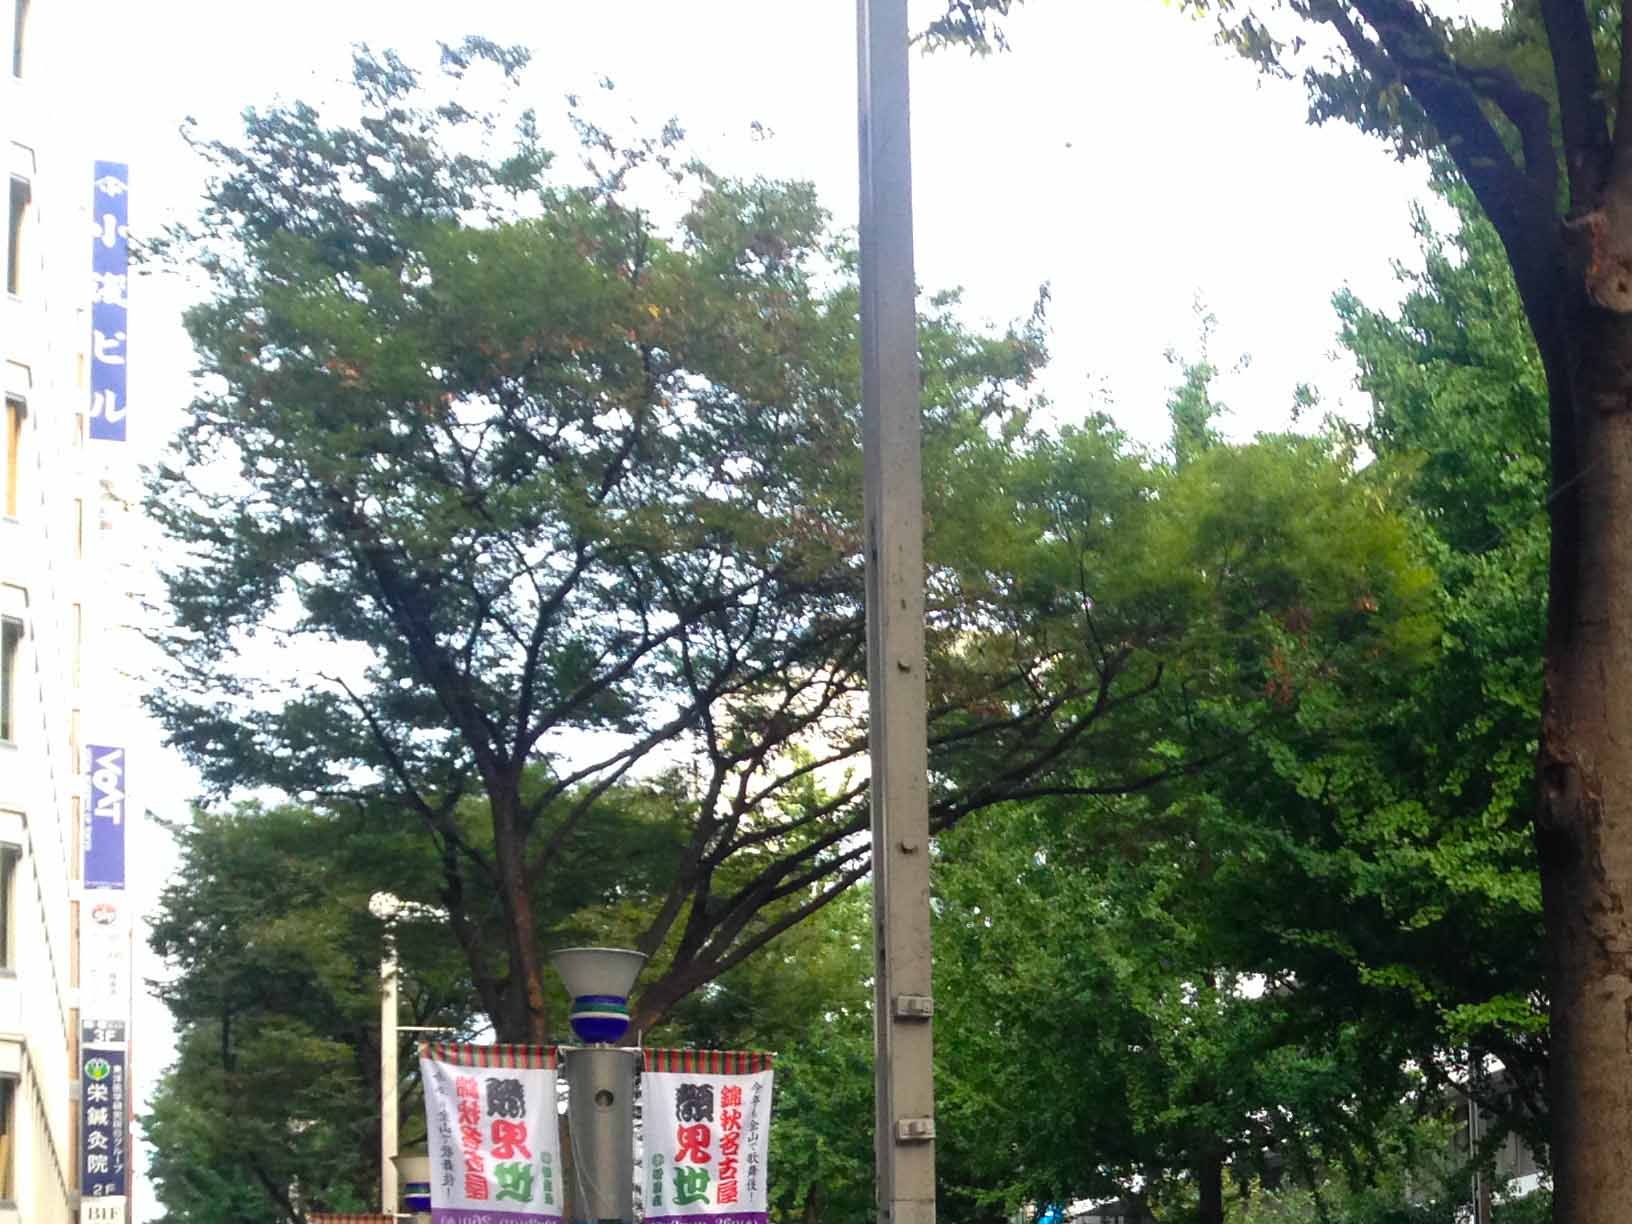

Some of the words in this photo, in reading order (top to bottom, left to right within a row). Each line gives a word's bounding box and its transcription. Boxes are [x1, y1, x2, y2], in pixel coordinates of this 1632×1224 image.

[93, 1028, 117, 1043] 3F
[87, 1083, 109, 1174] 栄鍼灸院
[716, 1084, 743, 1205] 錦秋名古屋
[93, 1184, 117, 1196] 2F
